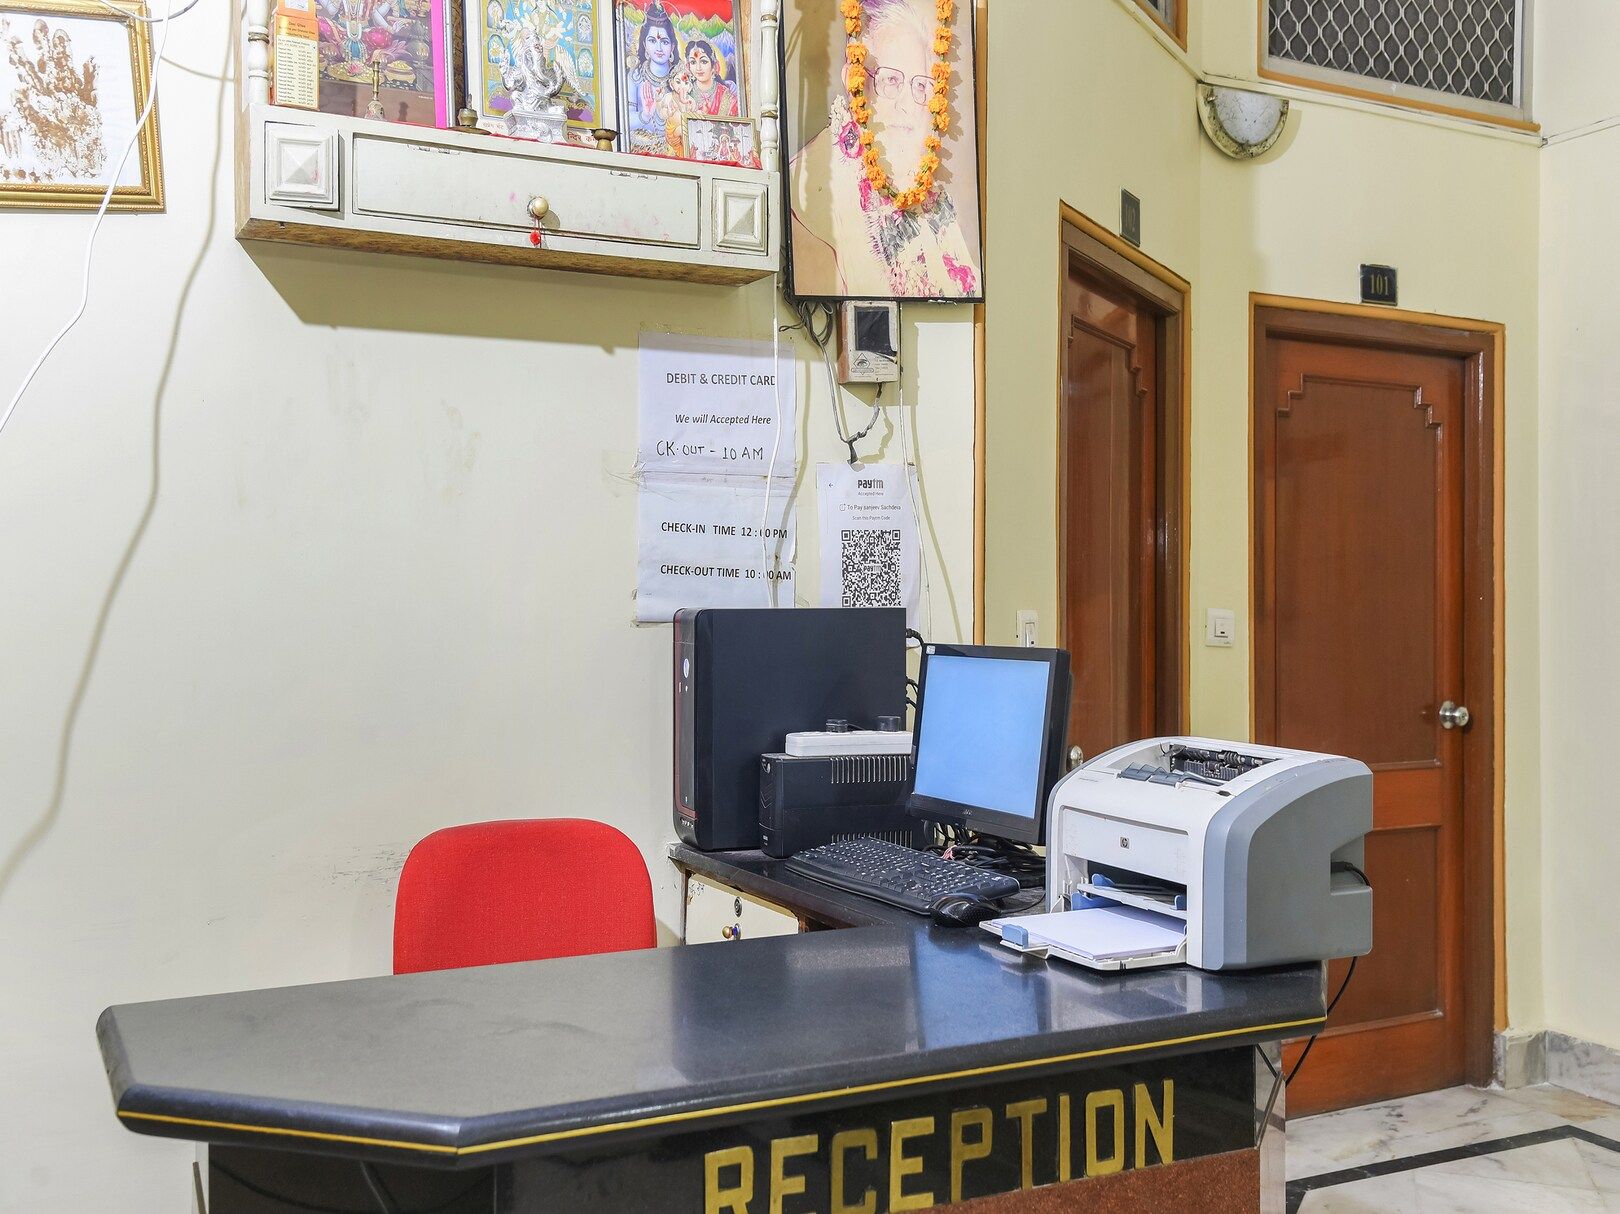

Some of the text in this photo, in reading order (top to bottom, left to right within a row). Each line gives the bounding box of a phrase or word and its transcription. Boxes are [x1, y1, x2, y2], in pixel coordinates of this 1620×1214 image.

[1370, 273, 1389, 296] 101
[666, 372, 696, 385] DEBIT
[699, 373, 708, 385] &
[711, 374, 747, 386] CREDIT
[675, 414, 772, 426] We will Accepted Here
[722, 447, 737, 461] 10
[741, 447, 764, 461] AM
[661, 521, 706, 534] CHECK-IN
[713, 524, 736, 536] TIME
[741, 526, 752, 537] 12
[773, 529, 788, 539] PM
[660, 564, 715, 577] CHECK-OUT
[717, 567, 740, 578] TIME
[745, 569, 756, 579] 10
[776, 570, 792, 581] AM
[704, 1079, 1174, 1214] RECEPTION
